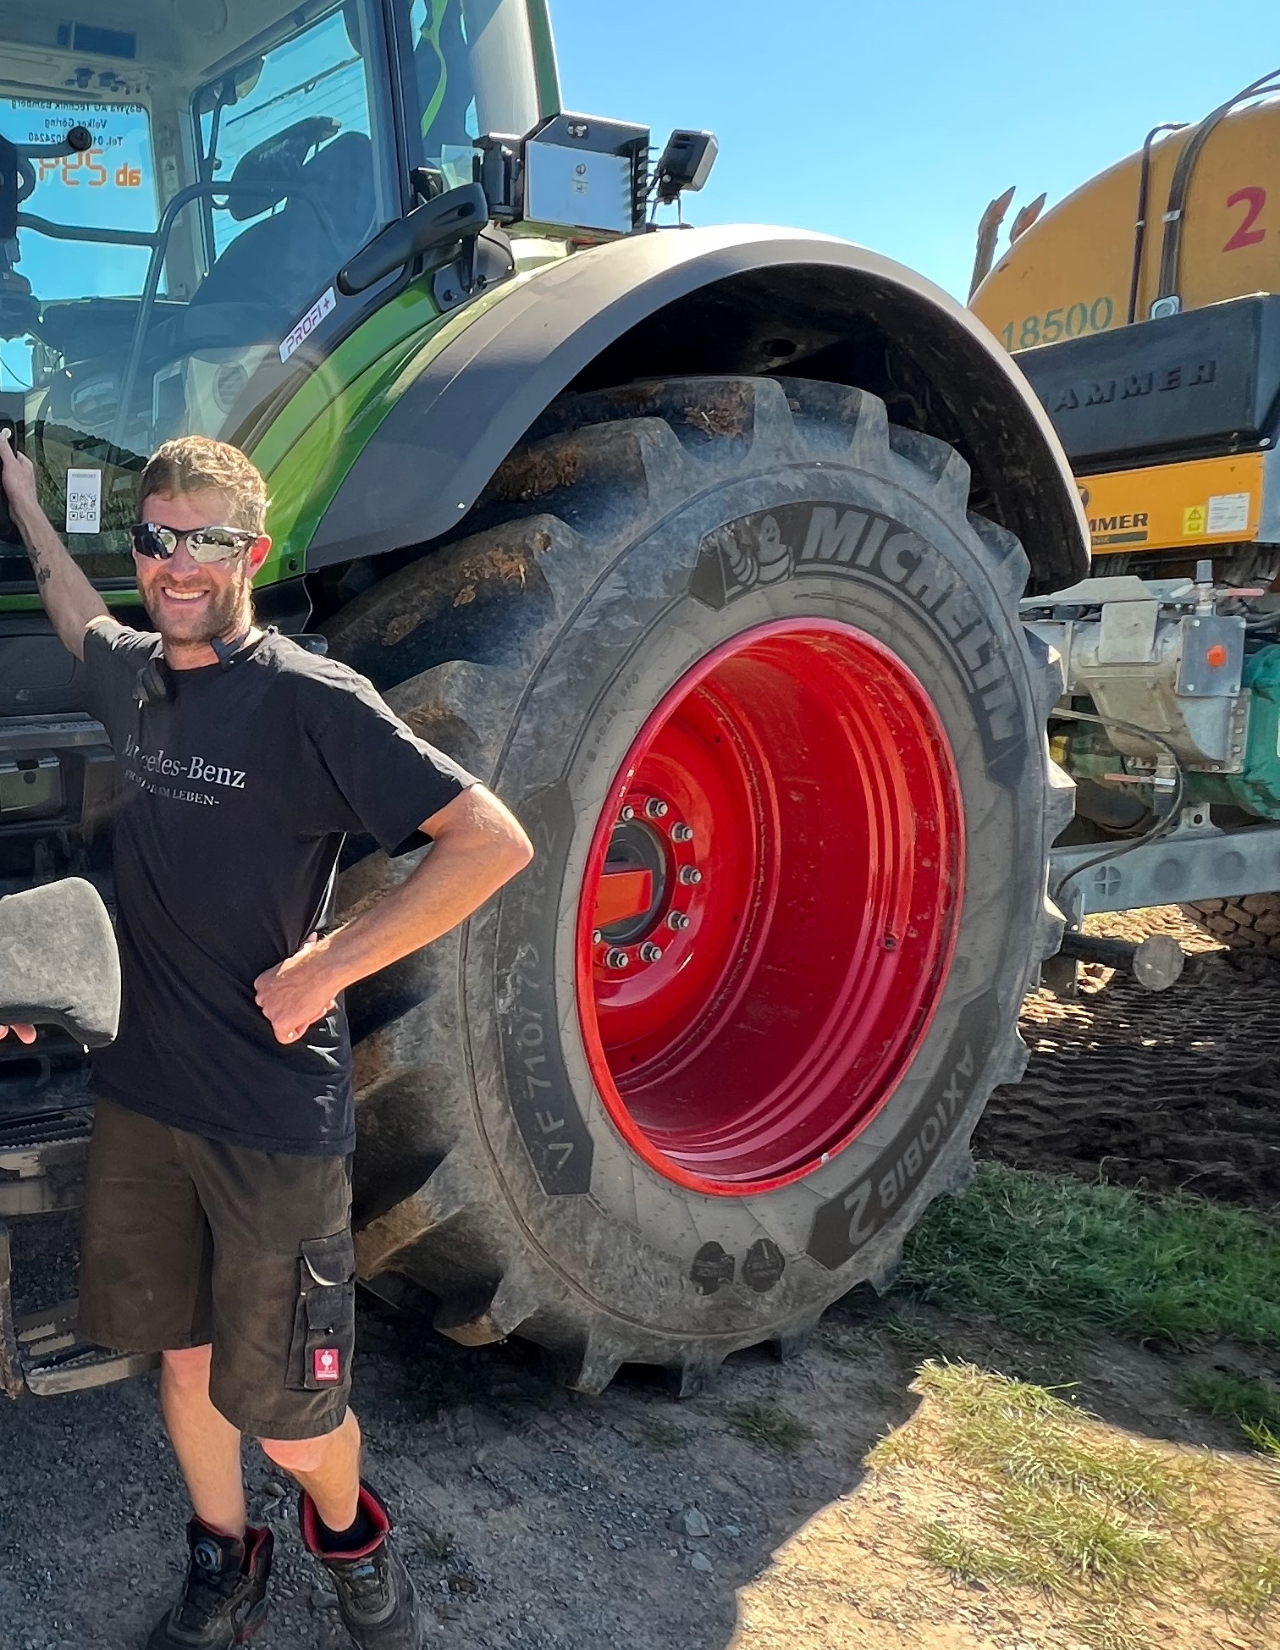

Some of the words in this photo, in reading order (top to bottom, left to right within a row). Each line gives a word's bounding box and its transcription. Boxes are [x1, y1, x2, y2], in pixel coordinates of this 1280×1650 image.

[1221, 186, 1267, 253] 2
[1001, 296, 1114, 351] 18500
[1041, 360, 1218, 413] AMMER
[801, 506, 1021, 742] MICHELIN
[878, 1041, 975, 1209] AXIOBIB
[843, 1177, 876, 1246] 2
